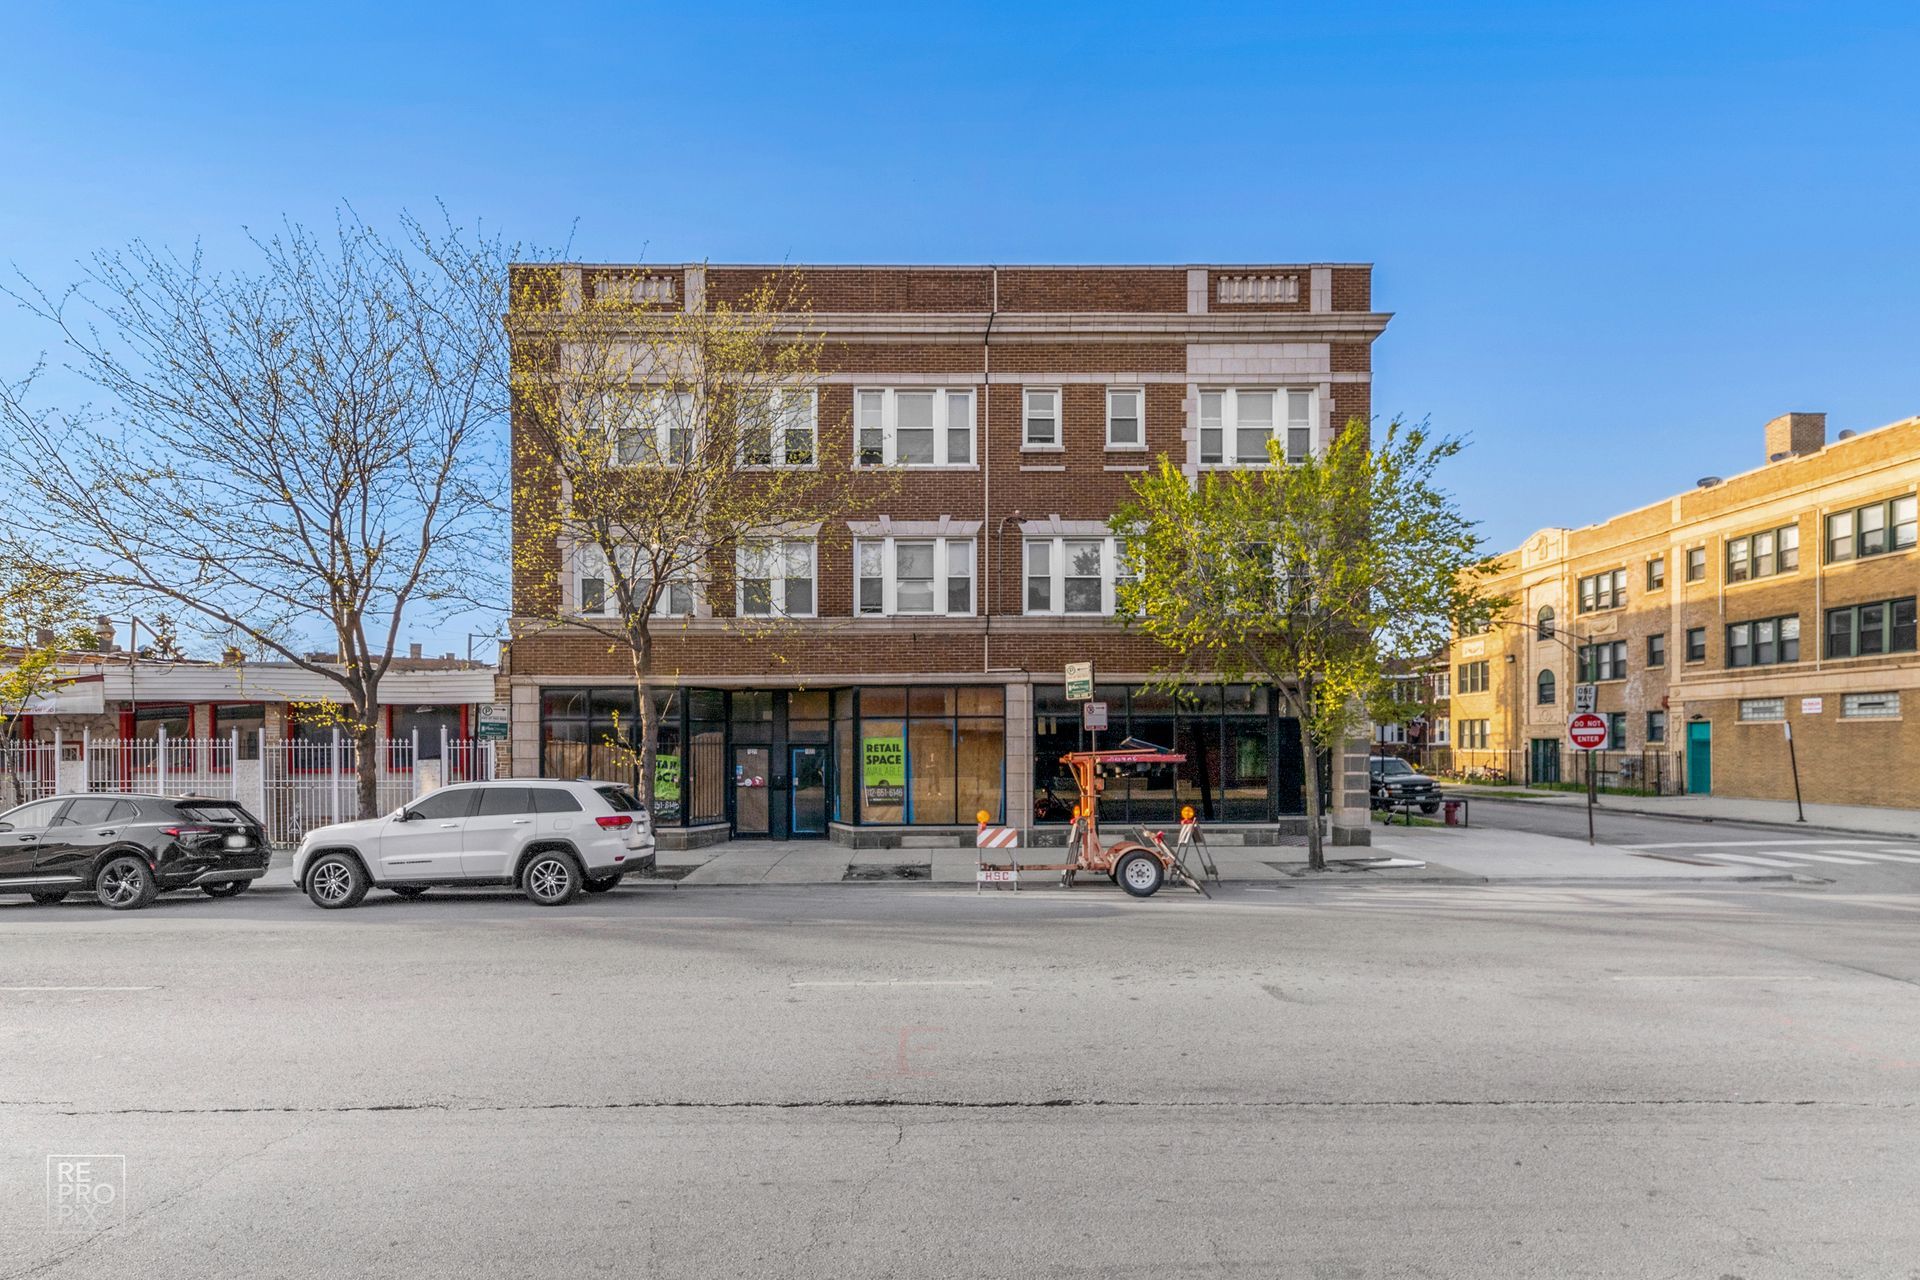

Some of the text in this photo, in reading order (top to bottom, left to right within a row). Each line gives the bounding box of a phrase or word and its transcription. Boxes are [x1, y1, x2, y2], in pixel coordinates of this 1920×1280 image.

[866, 744, 901, 752] RETAIL
[866, 755, 901, 764] SPACE
[866, 767, 902, 776] AVAILABLE
